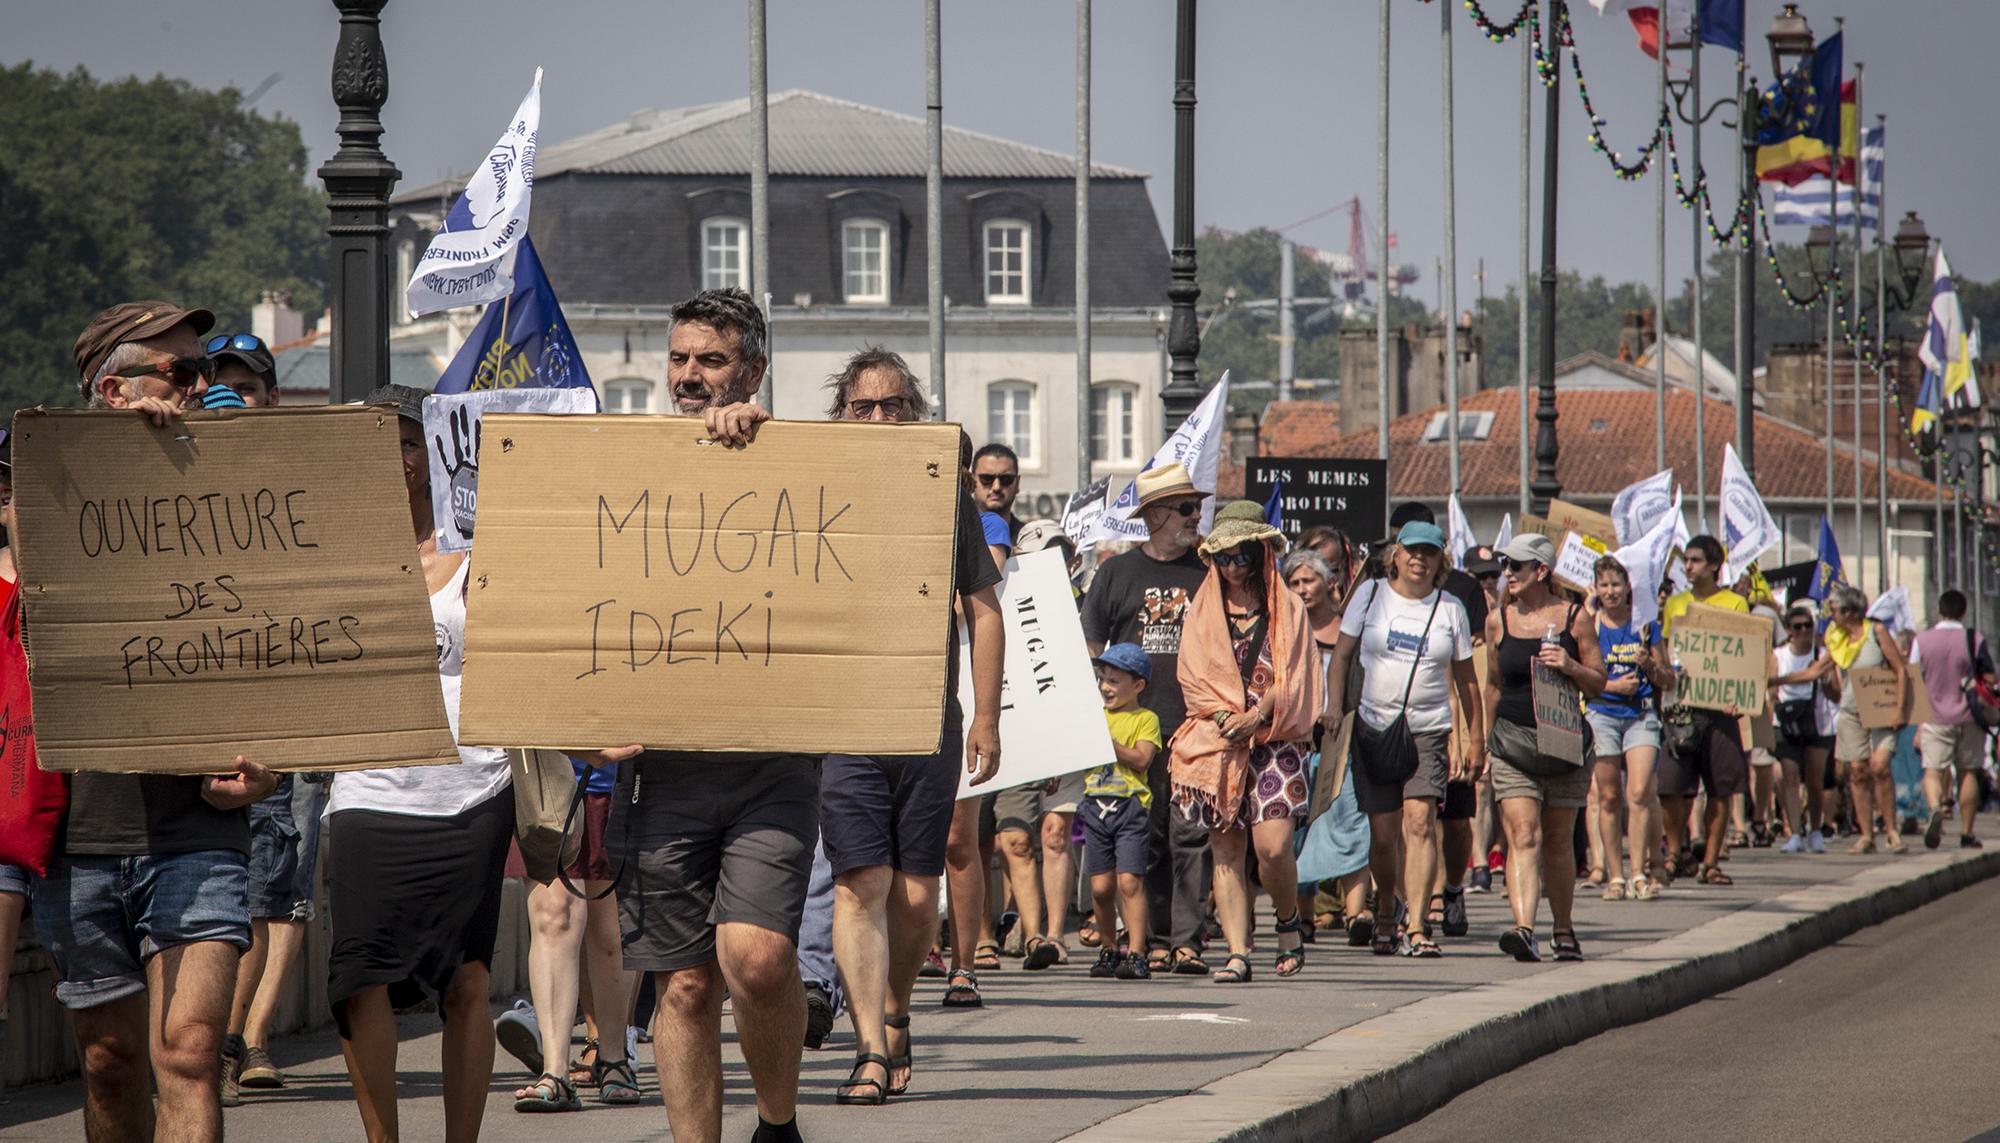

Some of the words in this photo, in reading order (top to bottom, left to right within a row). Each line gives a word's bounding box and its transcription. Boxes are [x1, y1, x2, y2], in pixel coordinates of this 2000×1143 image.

[492, 218, 519, 249] BRIM
[422, 247, 489, 263] FRONTERE
[1257, 468, 1292, 483] LES
[1307, 470, 1370, 486] MEMES
[454, 486, 477, 512] STO
[1280, 496, 1347, 511] ROITS
[79, 488, 319, 558] OUVERTURE
[598, 485, 854, 583] MUGAK
[1103, 516, 1150, 536] RONTERES
[1281, 519, 1302, 533] UR
[164, 575, 244, 620] DES
[120, 610, 364, 690] FRONTIÈRES
[1015, 596, 1056, 694] MUGAK
[1703, 655, 1719, 673] DA
[632, 774, 641, 804] Canon
